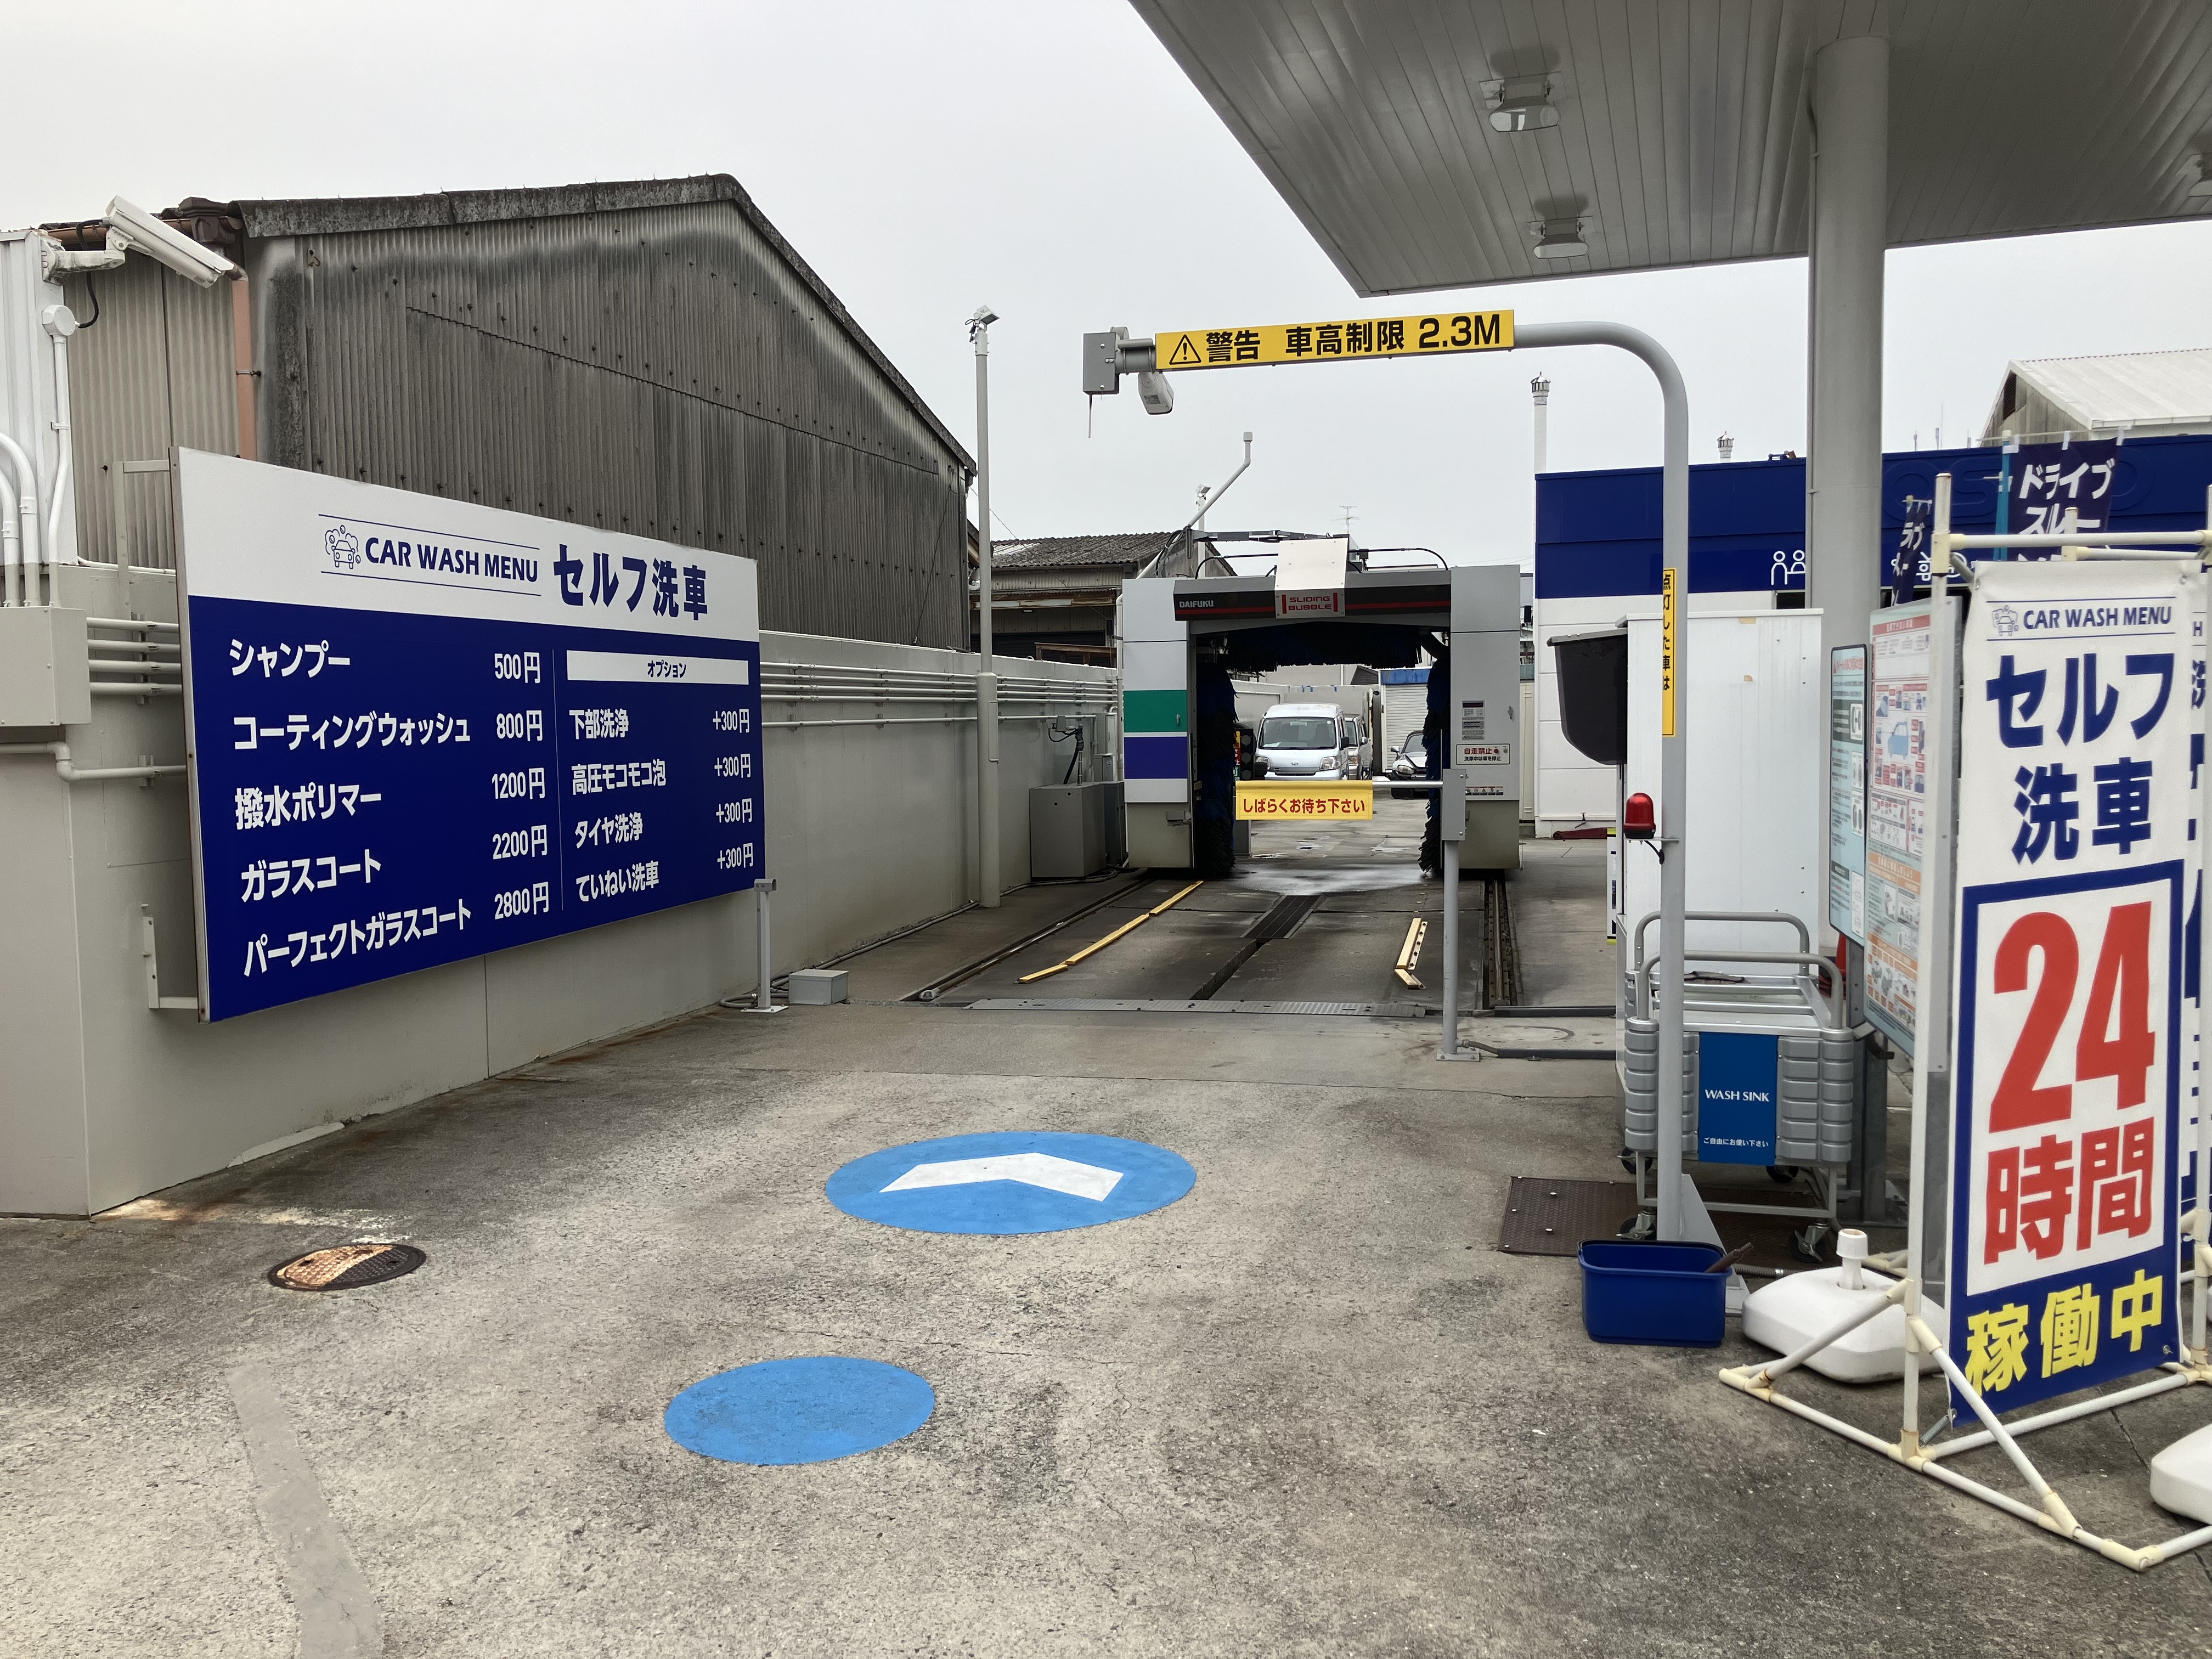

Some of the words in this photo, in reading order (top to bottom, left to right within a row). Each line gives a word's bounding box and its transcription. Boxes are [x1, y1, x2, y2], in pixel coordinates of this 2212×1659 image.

[1206, 331, 1261, 362] 警告
[1286, 320, 1404, 357] 車高制限
[1419, 314, 1500, 348] 2.3M
[2019, 457, 2115, 500] ドライブ
[365, 537, 411, 567] CAR
[416, 544, 479, 574] WASH
[484, 554, 538, 582] MENU
[554, 544, 708, 620] セルフ洗車
[2023, 610, 2059, 630] CAR
[2065, 607, 2118, 628] WASH
[2123, 606, 2172, 626] MENU
[229, 639, 350, 678] シャンプー
[494, 652, 540, 684] 500円
[647, 659, 686, 678] オプション
[569, 708, 629, 740] 下部洗浄
[713, 708, 750, 733] +300円
[1985, 653, 2175, 748] セルフ
[234, 711, 470, 750] コーティングウォッシュ
[496, 710, 543, 741] 800円
[572, 759, 665, 795] 高圧モコモコ泡
[714, 753, 751, 778] +300円
[235, 782, 381, 830] 撥水ポリマー
[492, 768, 545, 799] 1200円
[1243, 798, 1365, 815] しばらくお待ち下さい
[2011, 757, 2153, 865] 洗車
[575, 812, 643, 849] タイヤ洗浄
[716, 798, 752, 823] +300円
[241, 849, 381, 902] ガラスコート
[492, 825, 548, 860] 2200円
[576, 861, 659, 901] ていねい洗車
[717, 843, 753, 869] +300円
[244, 899, 471, 977] パーフェクトガラスコート
[494, 882, 549, 919] 2800円
[1989, 901, 2155, 1133] 24
[1705, 1090, 1740, 1101] WASH
[1743, 1091, 1769, 1102] SINK
[1703, 1137, 1769, 1147] ご自由にお使い下さい
[1984, 1117, 2154, 1265] 時間
[1965, 1269, 2164, 1397] 稼働中
